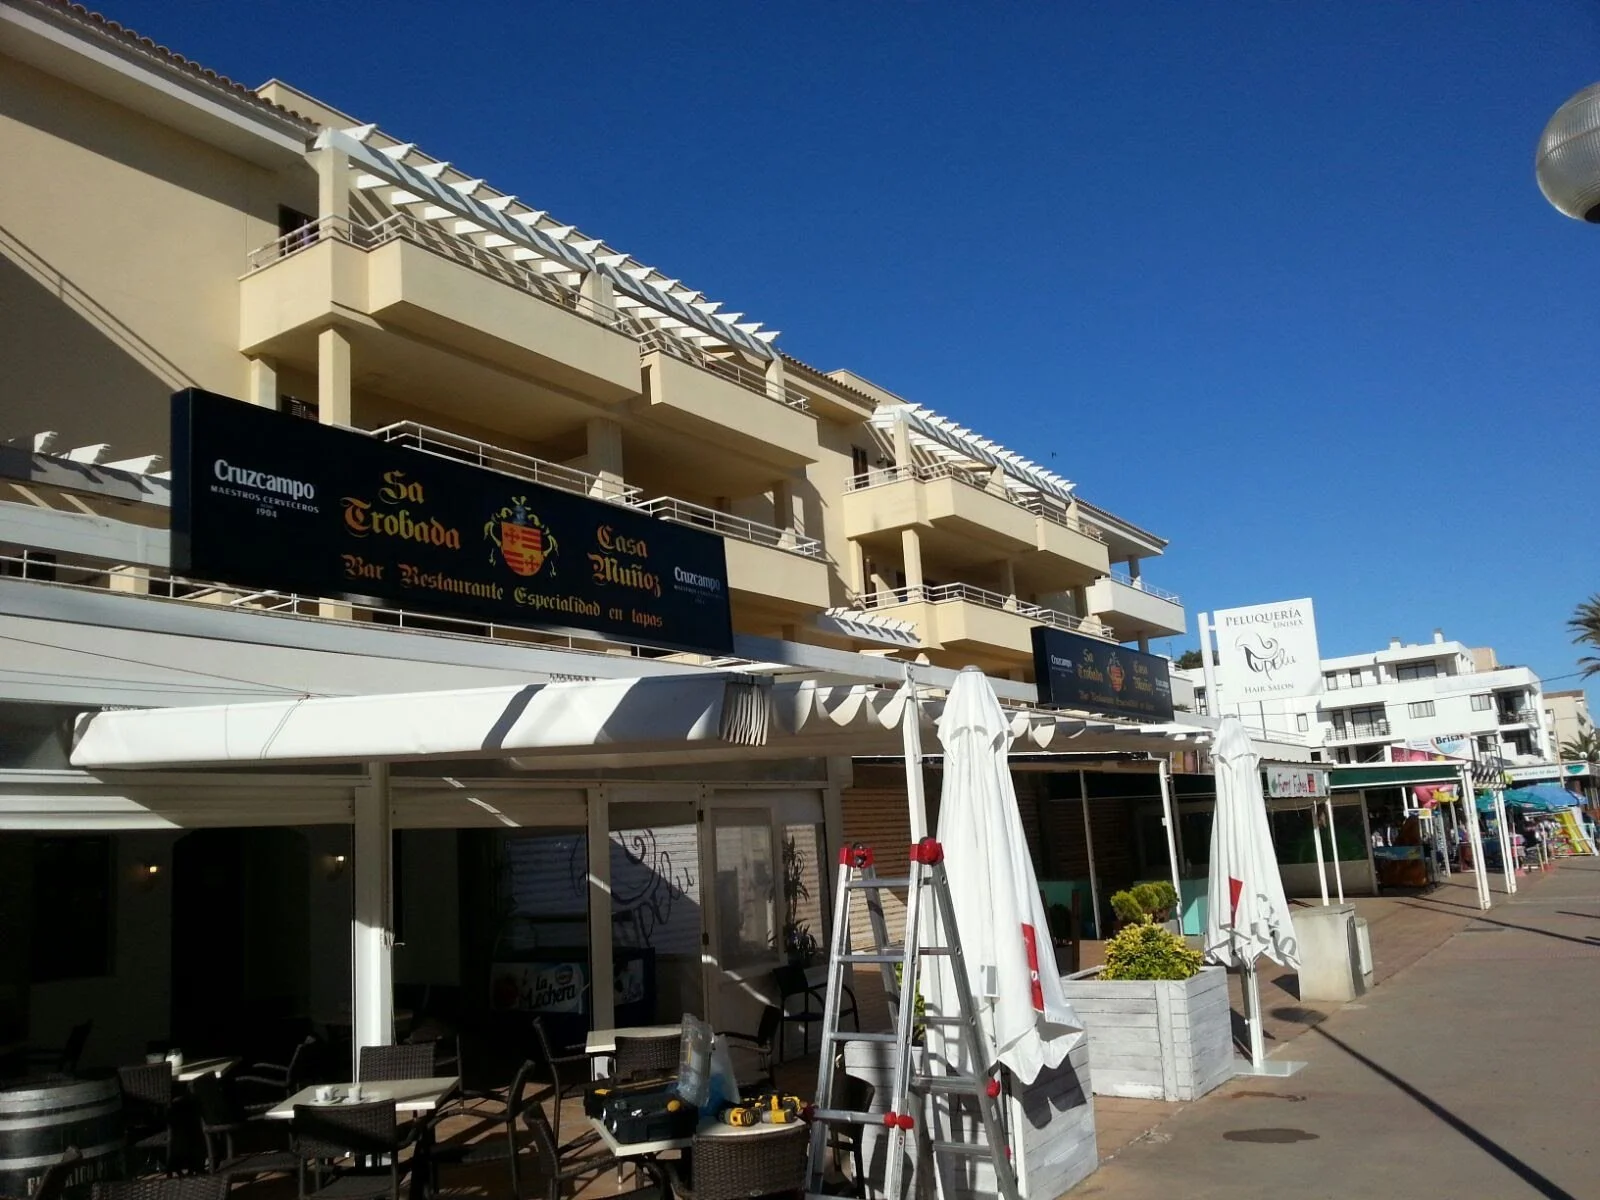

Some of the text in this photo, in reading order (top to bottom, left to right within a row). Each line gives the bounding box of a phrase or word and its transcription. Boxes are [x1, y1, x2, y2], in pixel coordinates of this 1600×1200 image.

[213, 458, 315, 501] Cruzcampo
[378, 469, 425, 505] Sa
[210, 484, 320, 514] MAESTROS CERVECEROS
[256, 507, 278, 519] 1904
[340, 496, 462, 550] Trobada
[596, 523, 649, 559] Casa
[340, 552, 664, 628] Bar Restaurante Especialidad en tapas
[587, 552, 662, 598] Muñoz
[674, 565, 721, 593] Cruzcampo
[1225, 607, 1302, 627] PELUQUERÍA
[1435, 733, 1465, 745] Brisas
